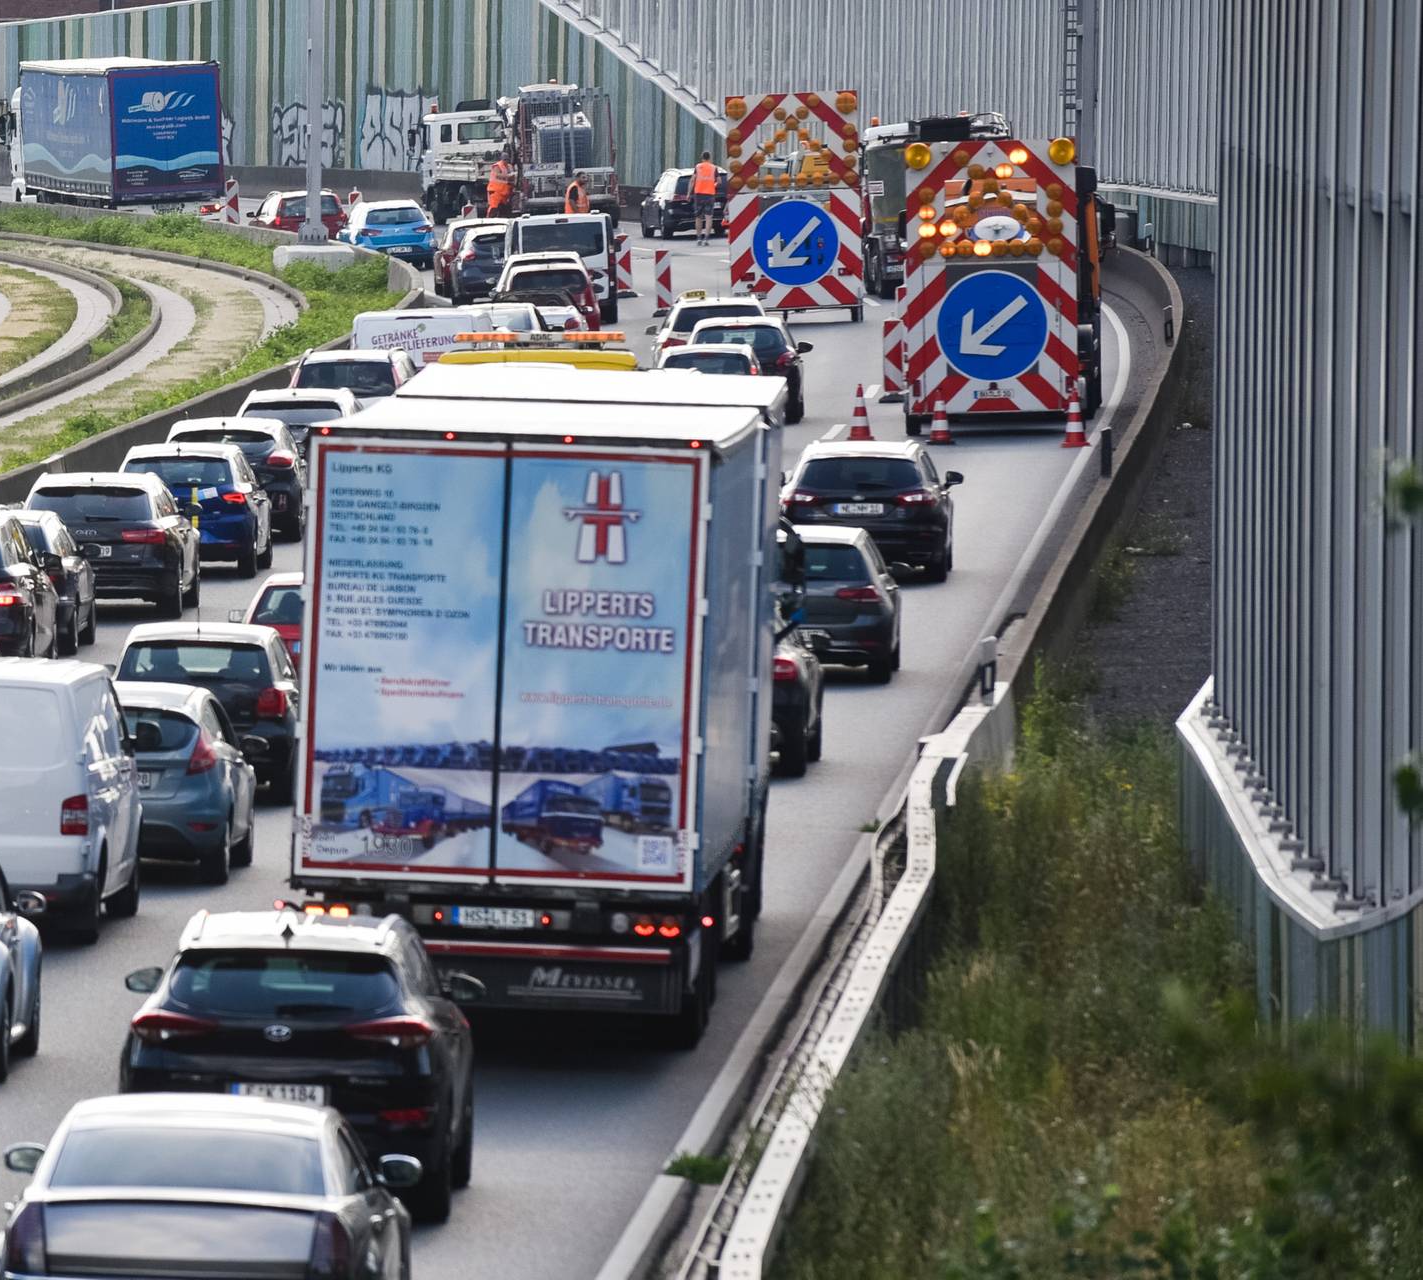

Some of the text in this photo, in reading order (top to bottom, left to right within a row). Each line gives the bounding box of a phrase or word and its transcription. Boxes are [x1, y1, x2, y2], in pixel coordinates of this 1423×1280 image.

[530, 333, 553, 341] ADAC
[332, 463, 393, 474] Lipperts KG
[388, 573, 447, 583] TRANSPORTE
[327, 583, 364, 592] BUREAU
[366, 584, 377, 592] DE
[542, 588, 655, 619] LIPPERTS
[523, 620, 675, 654] TRANSPORTE
